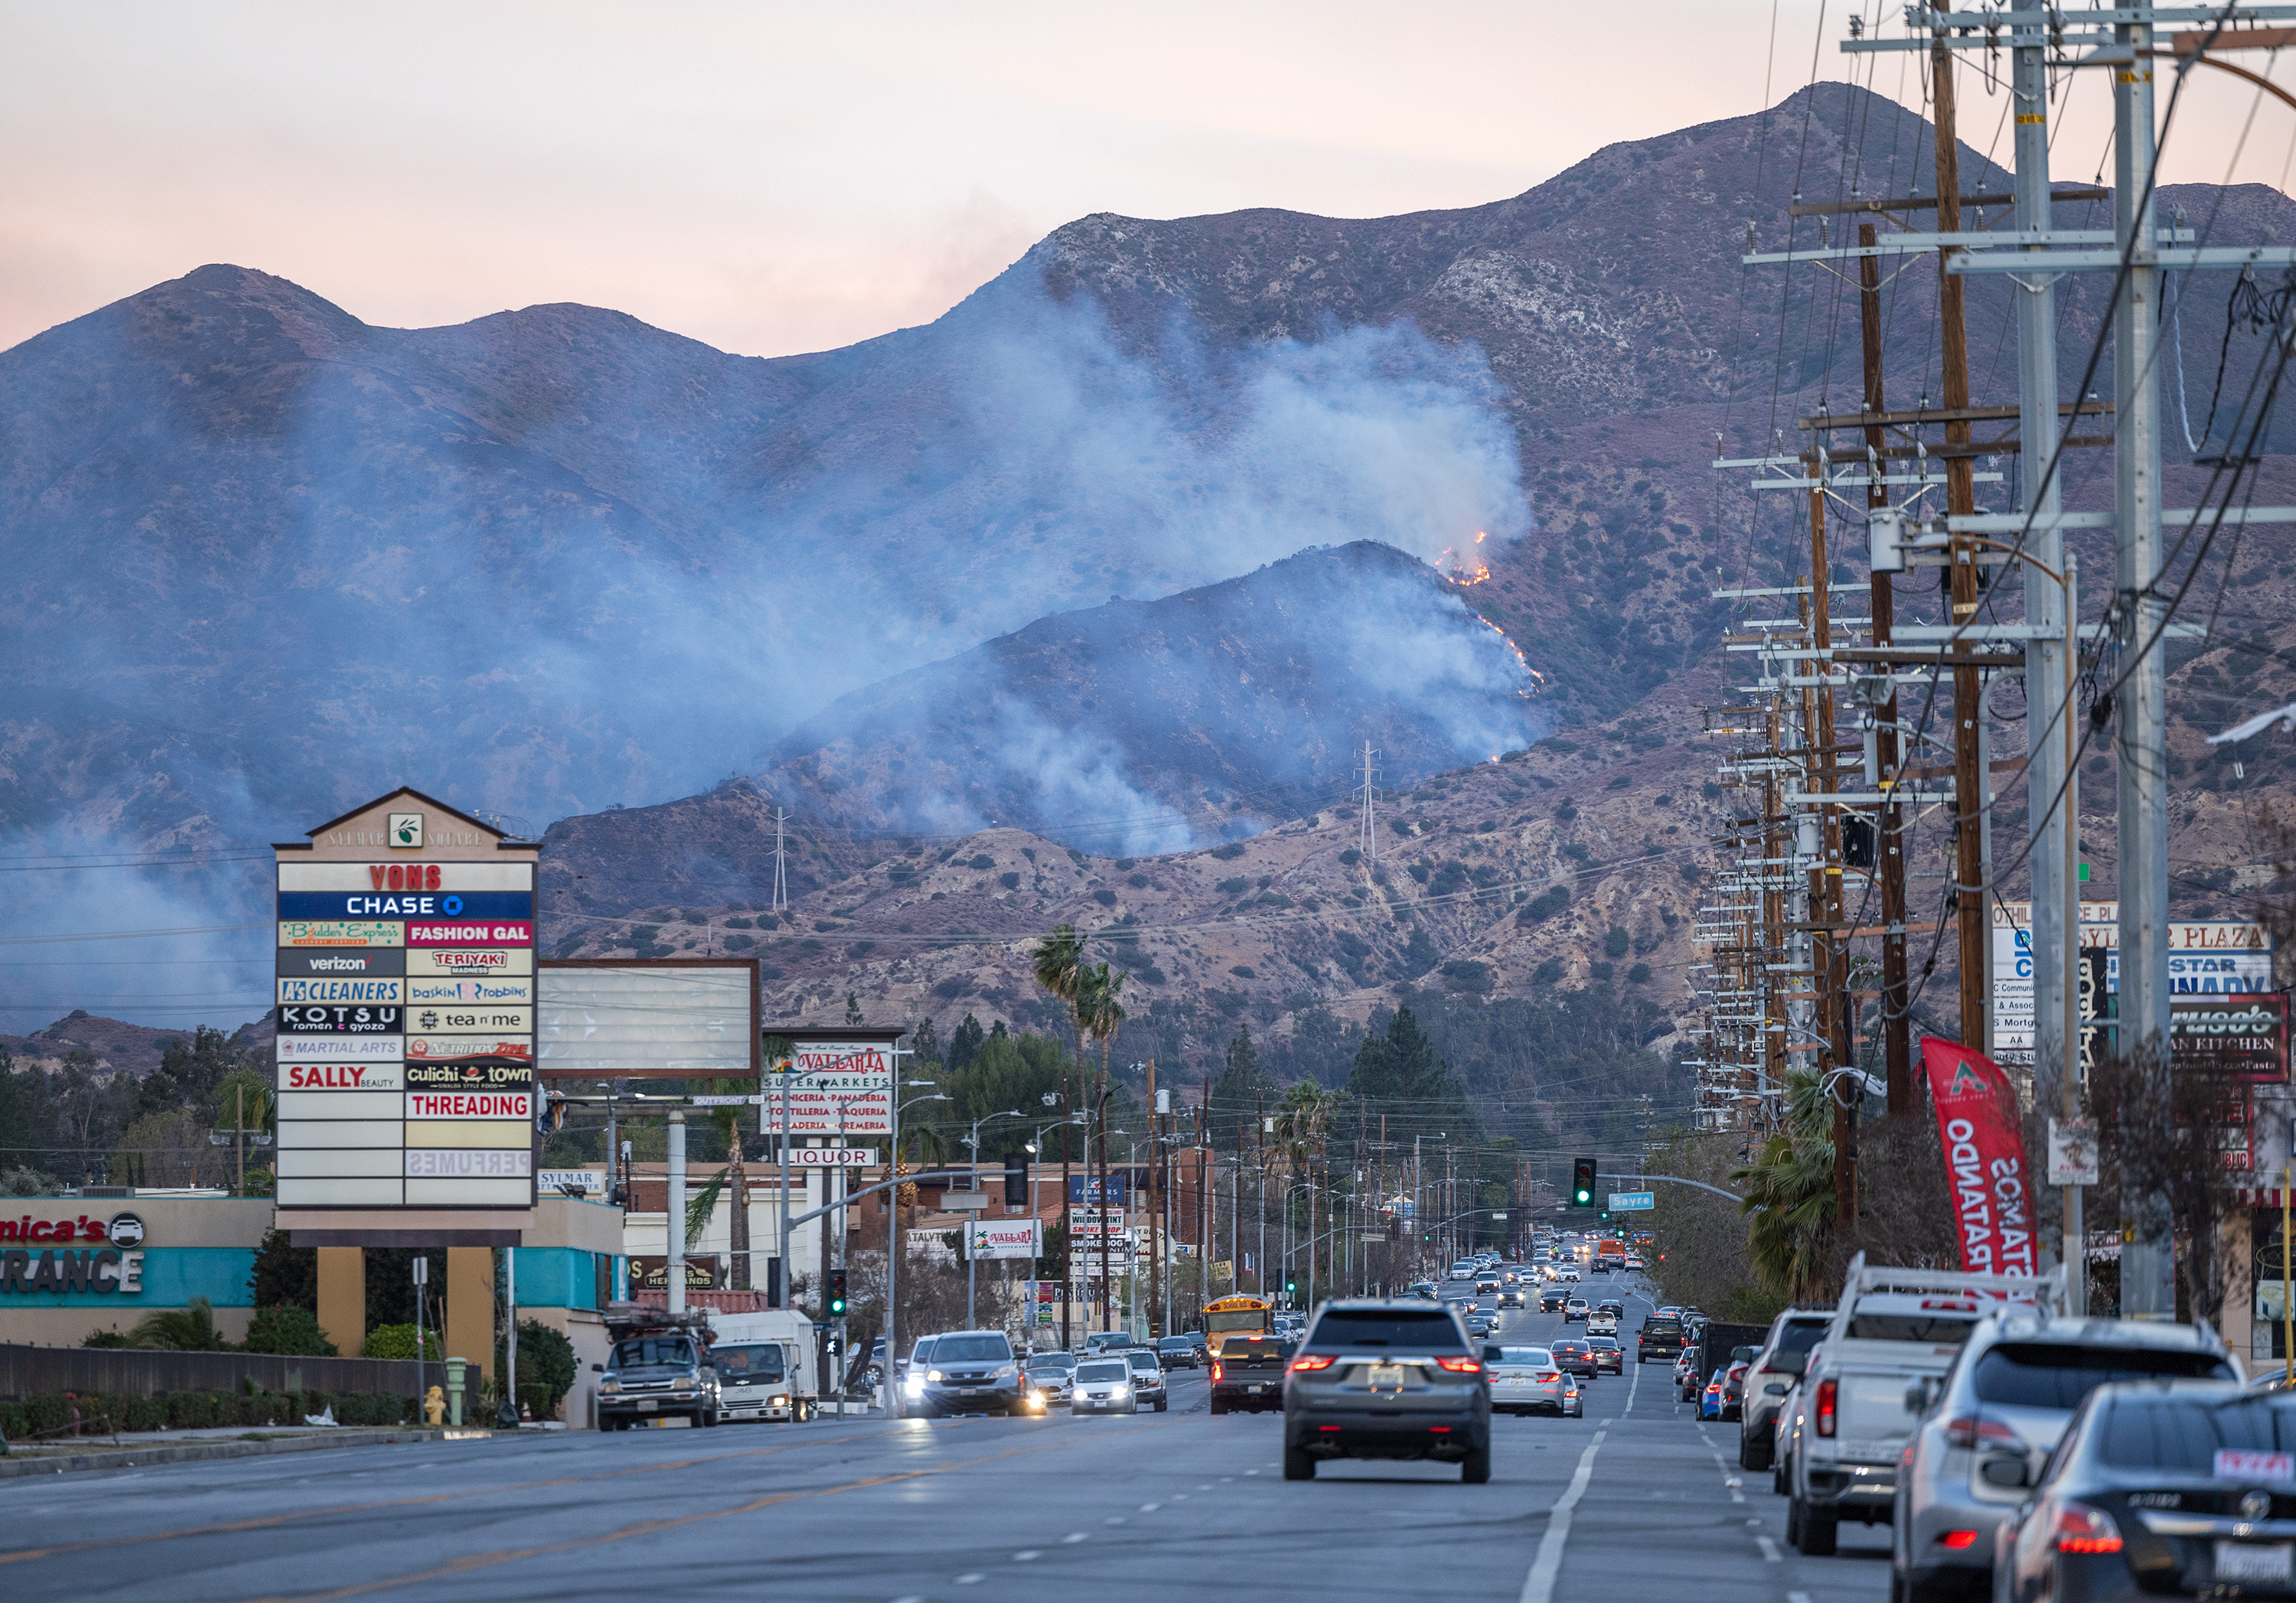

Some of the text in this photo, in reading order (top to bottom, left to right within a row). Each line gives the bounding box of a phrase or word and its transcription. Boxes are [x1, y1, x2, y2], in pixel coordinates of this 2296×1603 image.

[370, 865, 442, 890] VONS
[347, 897, 435, 914] CHASE
[346, 923, 399, 943] Express
[411, 927, 529, 940] FASHION GAL
[2183, 927, 2265, 948] PLAZA
[309, 956, 366, 970] verizon
[435, 953, 505, 965] TERIYAKI
[2170, 959, 2236, 973] STAR
[309, 982, 398, 1001] CLEANERS
[413, 986, 455, 999] baskin
[484, 986, 527, 999] robbins
[2009, 1001, 2033, 1009] Assoc
[283, 1007, 396, 1023] KOTSU
[446, 1014, 475, 1026] tea
[492, 1015, 520, 1026] me
[349, 1023, 386, 1032] gyoza
[296, 1042, 396, 1053] MARTIAL ARTS
[2196, 1038, 2275, 1051] KITCHEN
[798, 1047, 886, 1074] VALLARTA
[289, 1066, 367, 1088] SALLY
[407, 1066, 532, 1082] culichi town
[765, 1077, 889, 1087] SUERMARKETS
[831, 1093, 887, 1102] PANADERIA
[413, 1096, 527, 1116] THREADING
[771, 1107, 887, 1116] TOTILLERIA TAQUERIA
[541, 1173, 592, 1183] SYLMAR
[1613, 1196, 1649, 1207] Sayre
[2, 1249, 146, 1294] RANCE
